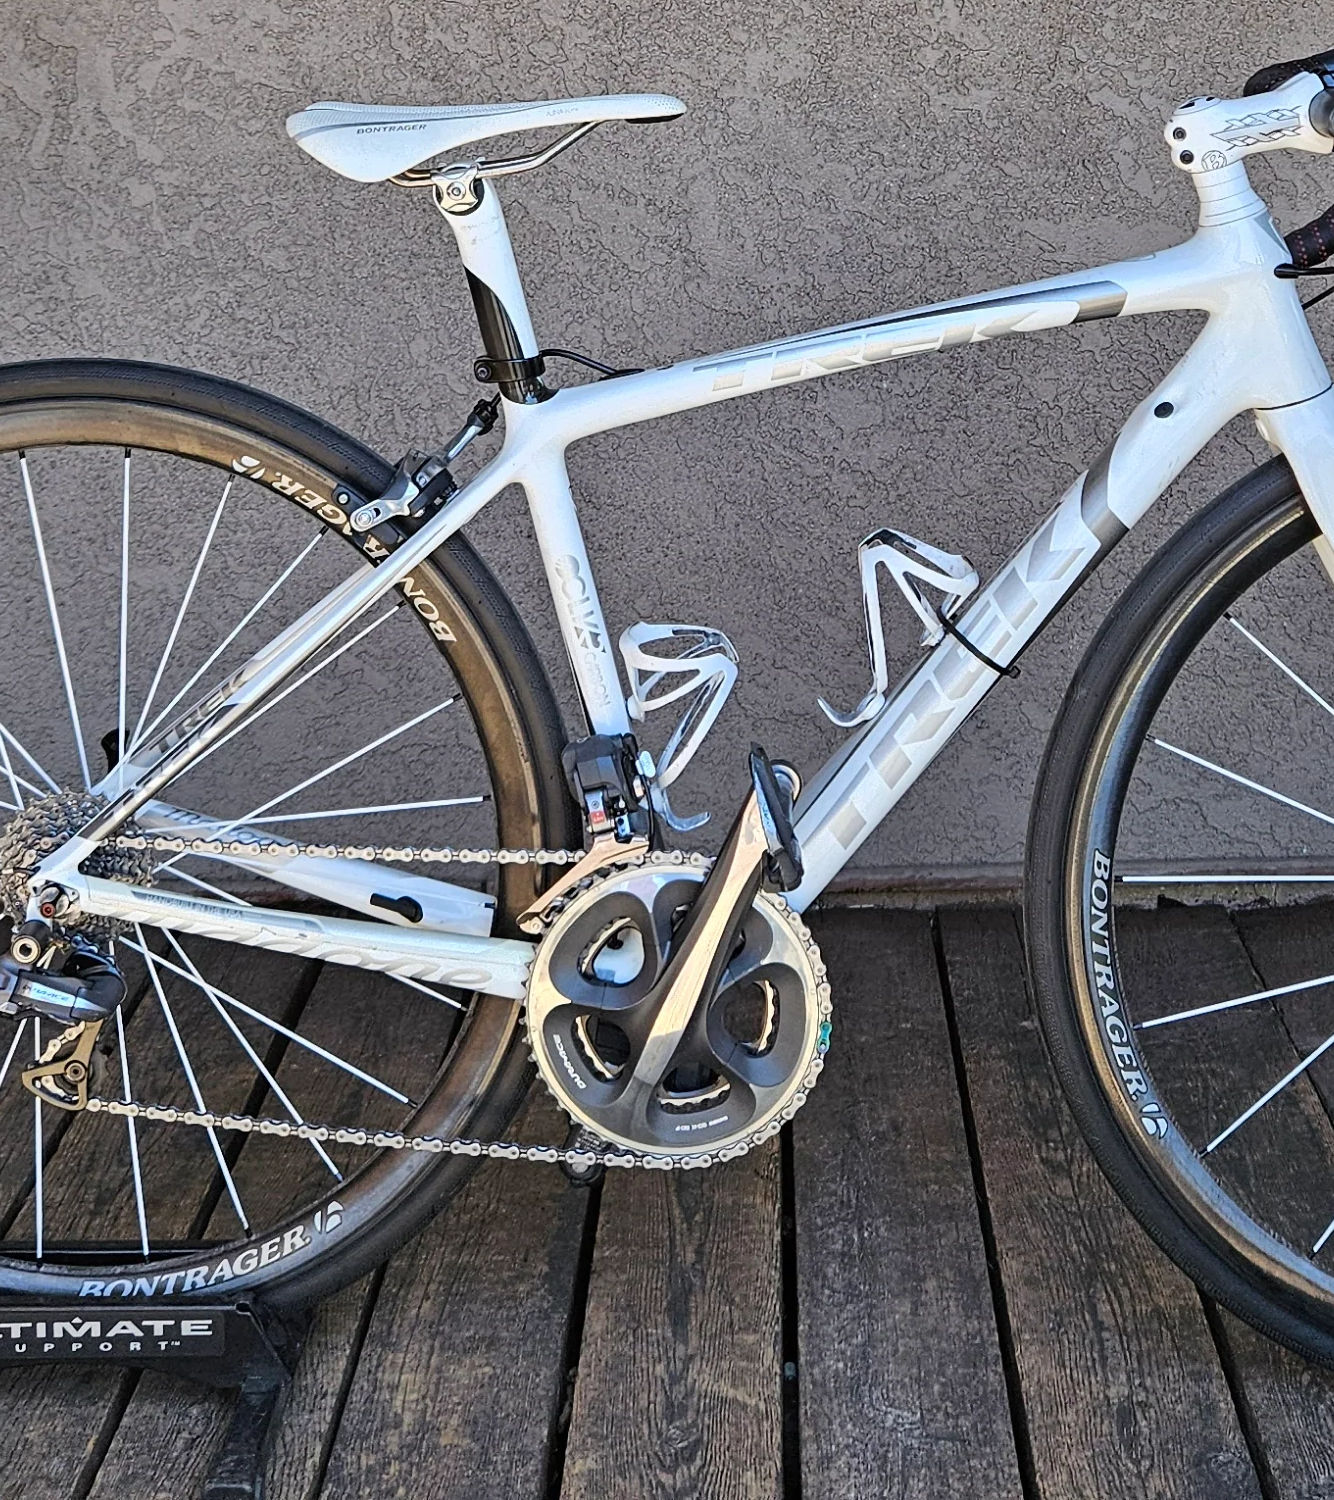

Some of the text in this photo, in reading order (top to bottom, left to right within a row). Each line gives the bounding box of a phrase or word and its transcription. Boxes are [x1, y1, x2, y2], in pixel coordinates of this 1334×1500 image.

[356, 123, 429, 136] BONTRAGER
[692, 309, 1039, 392] TREK
[148, 668, 247, 755] TREK
[803, 507, 1086, 850] TREK
